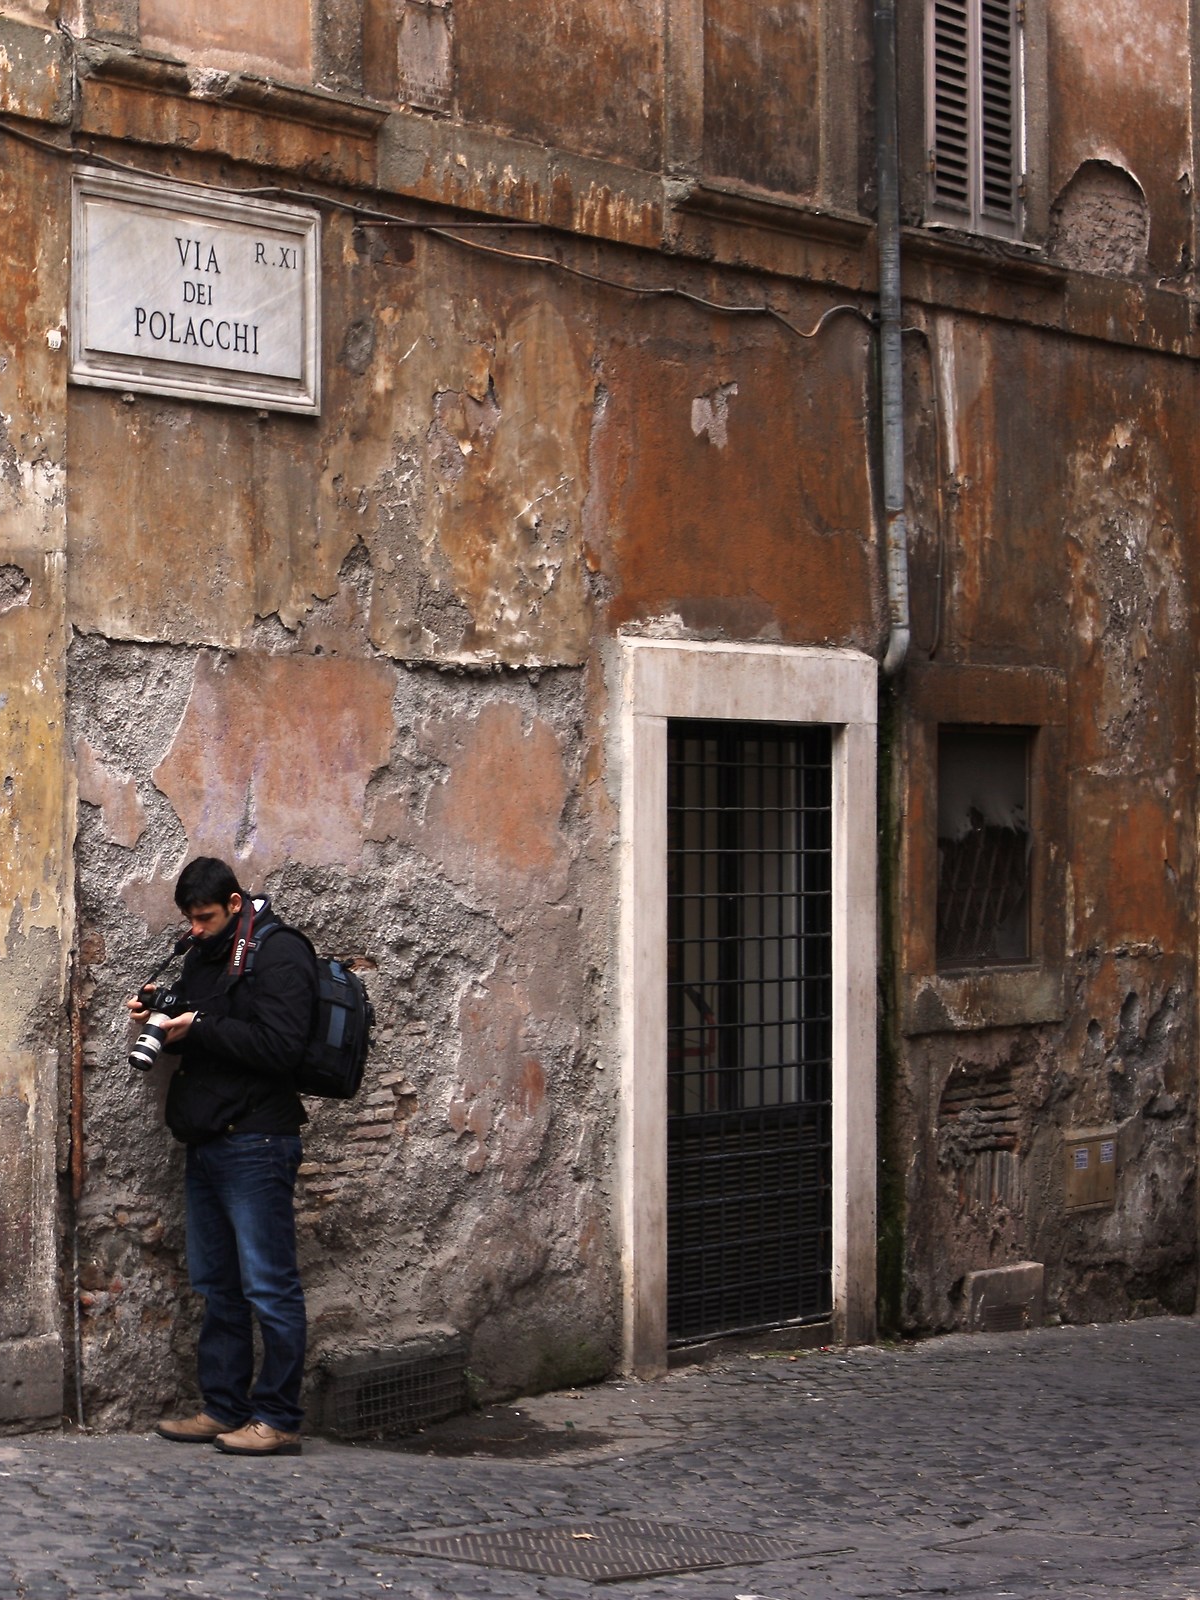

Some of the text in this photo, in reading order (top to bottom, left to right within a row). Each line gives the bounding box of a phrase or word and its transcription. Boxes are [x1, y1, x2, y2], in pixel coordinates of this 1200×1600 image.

[174, 236, 222, 275] VIA
[183, 280, 213, 306] DEI
[134, 306, 260, 355] POLACCHI
[233, 938, 246, 967] Canon
